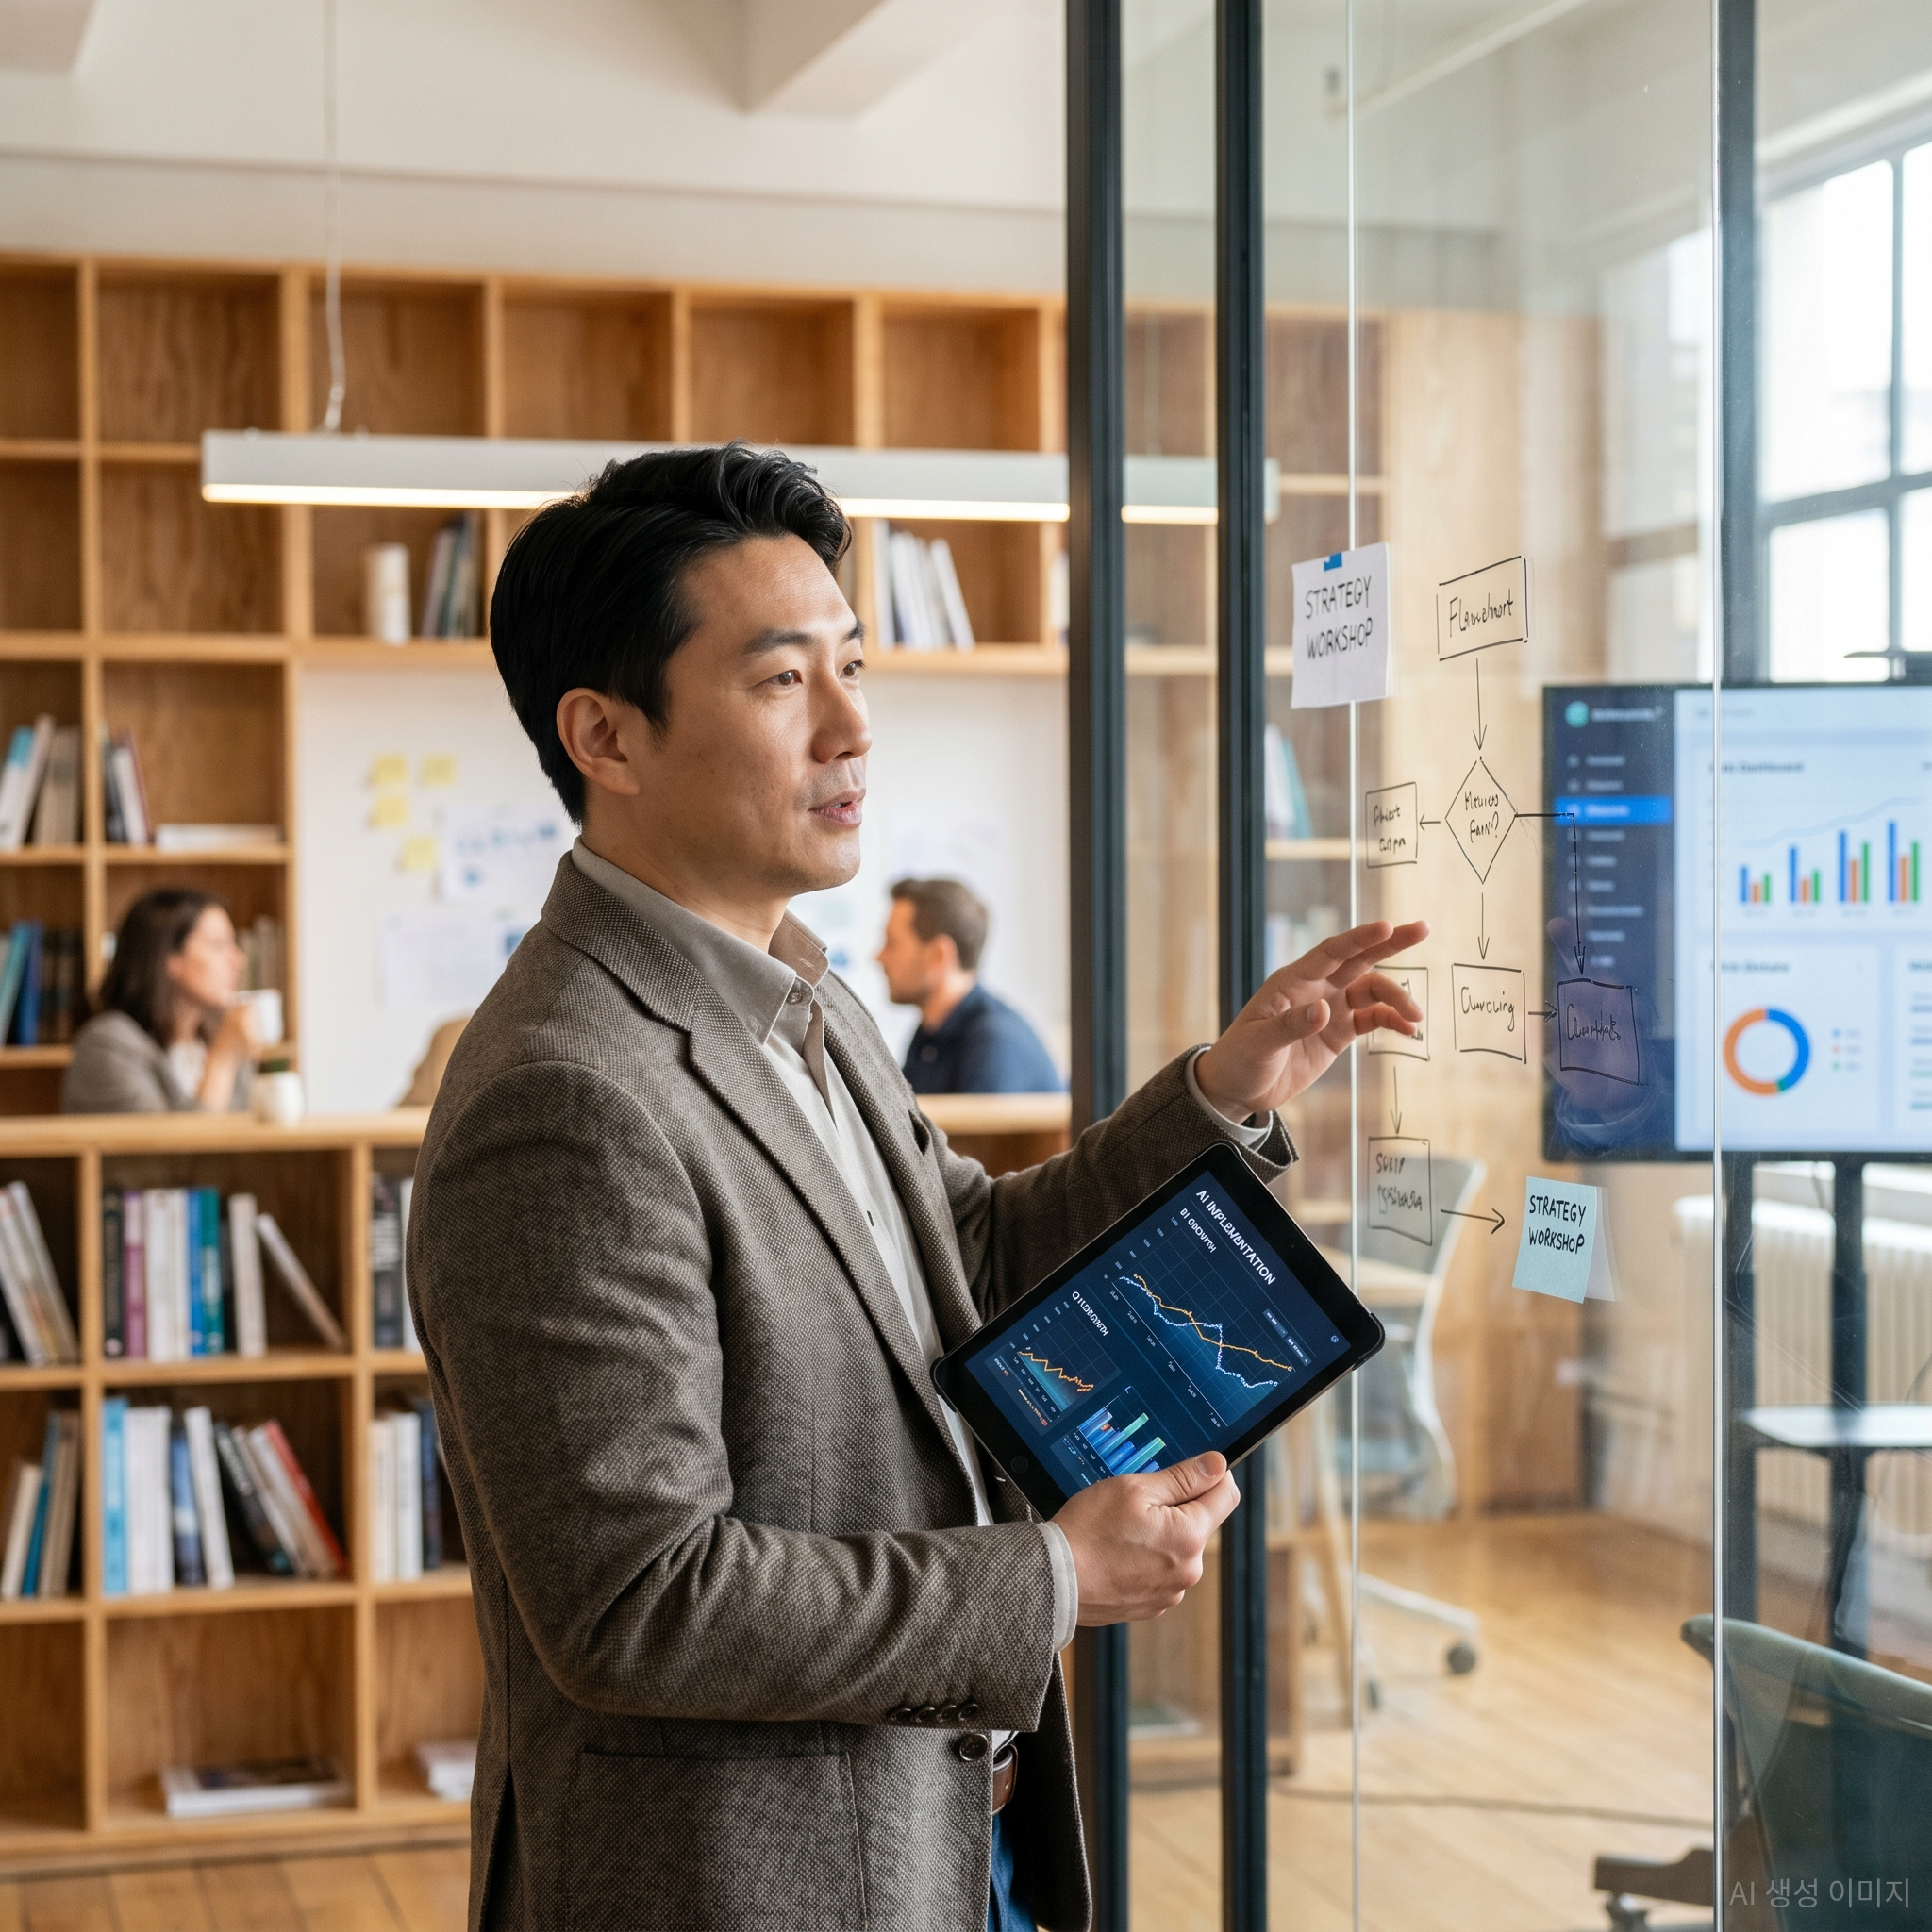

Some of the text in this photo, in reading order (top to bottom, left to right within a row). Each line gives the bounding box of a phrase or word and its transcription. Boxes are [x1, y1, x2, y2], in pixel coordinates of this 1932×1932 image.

[1306, 575, 1372, 619] STRATEGY
[1307, 617, 1374, 659] WORKSHOP
[1194, 1189, 1211, 1204] AI
[1529, 1194, 1587, 1228] STRATEGY
[1528, 1226, 1585, 1255] WORKSHOP
